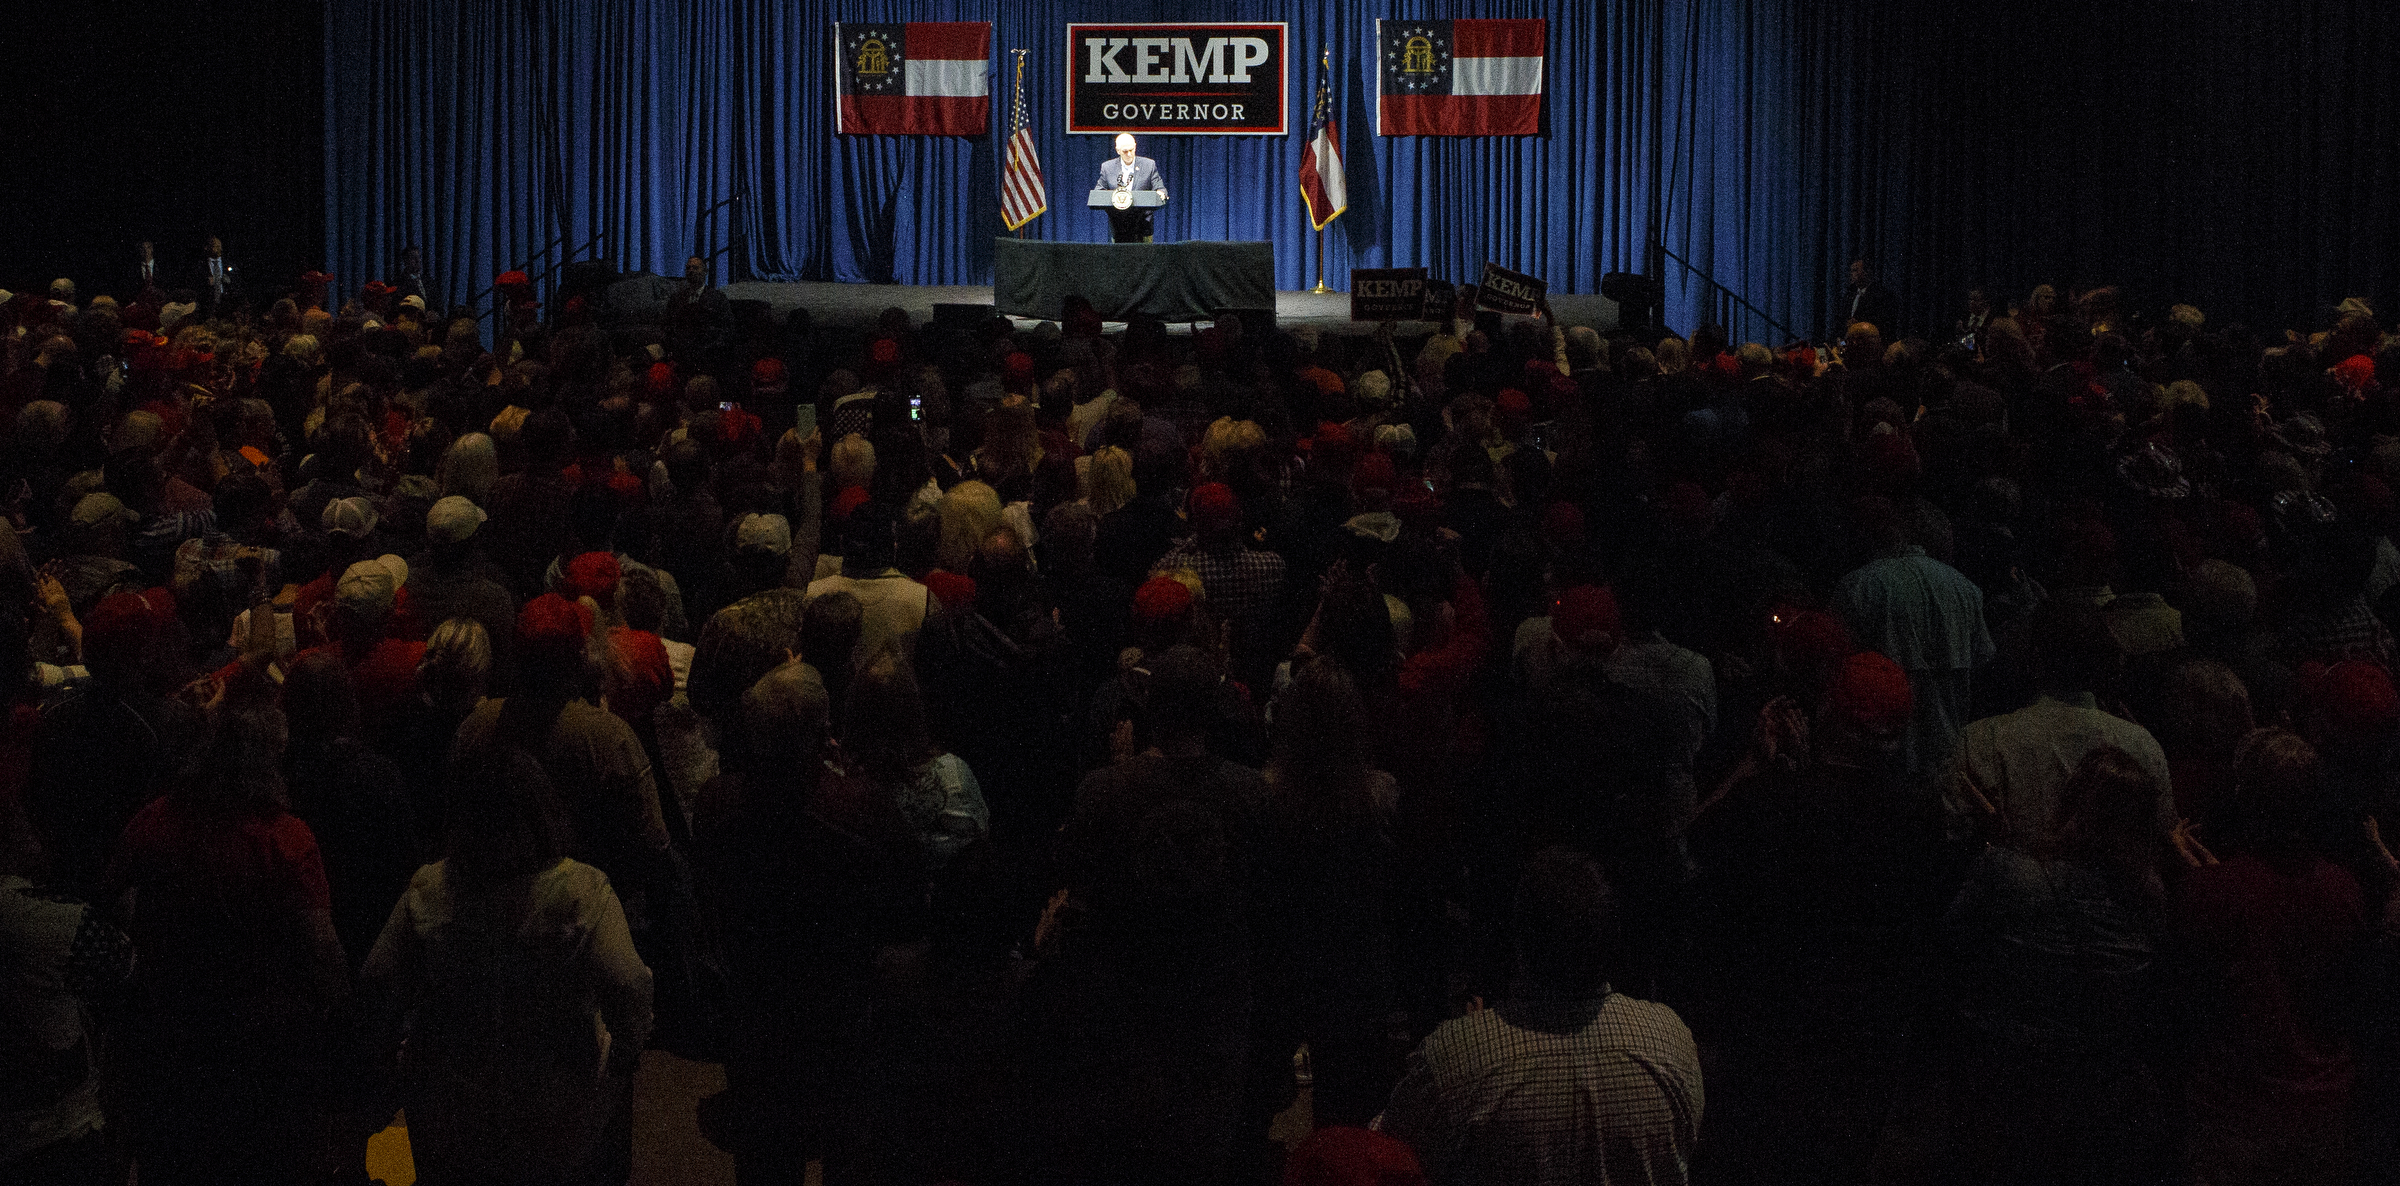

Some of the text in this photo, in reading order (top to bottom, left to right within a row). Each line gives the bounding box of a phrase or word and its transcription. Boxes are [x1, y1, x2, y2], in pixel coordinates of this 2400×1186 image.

[1085, 37, 1269, 83] KEMP
[1103, 103, 1246, 120] GOVERNOR
[1357, 279, 1422, 298] KEMP
[1485, 271, 1541, 303] KEMP
